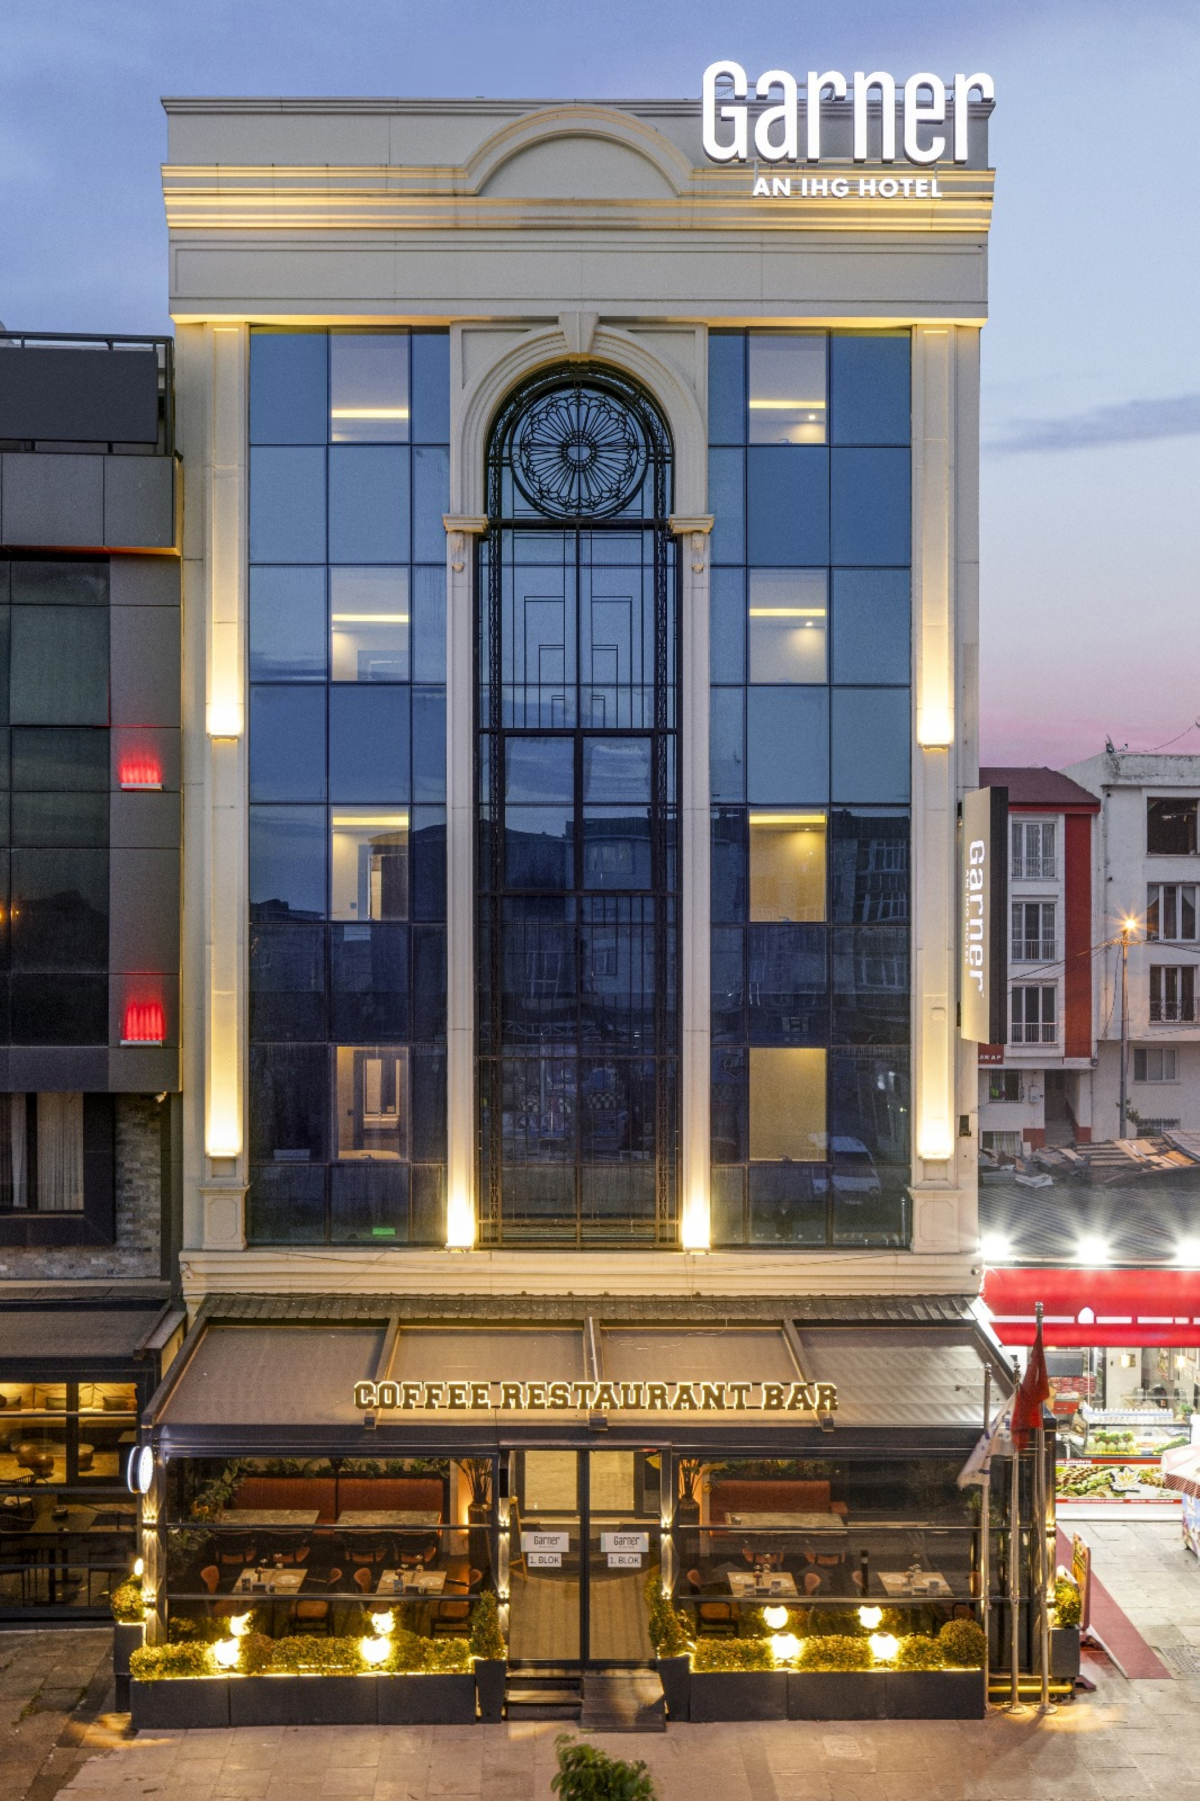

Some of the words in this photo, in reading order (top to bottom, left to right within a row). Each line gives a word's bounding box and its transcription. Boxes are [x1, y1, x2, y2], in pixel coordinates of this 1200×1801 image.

[702, 60, 994, 165] Garner
[752, 177, 791, 198] AN
[801, 177, 849, 199] IHG
[859, 178, 943, 199] HOTEL
[970, 840, 985, 992] Garner
[354, 1381, 491, 1409] COFFEE
[500, 1381, 752, 1410] RESTAURANT
[762, 1382, 839, 1410] BAR
[533, 1535, 560, 1546] Garner
[613, 1535, 640, 1546] Garner
[538, 1556, 560, 1564] BLOK
[618, 1556, 640, 1564] BLOK
